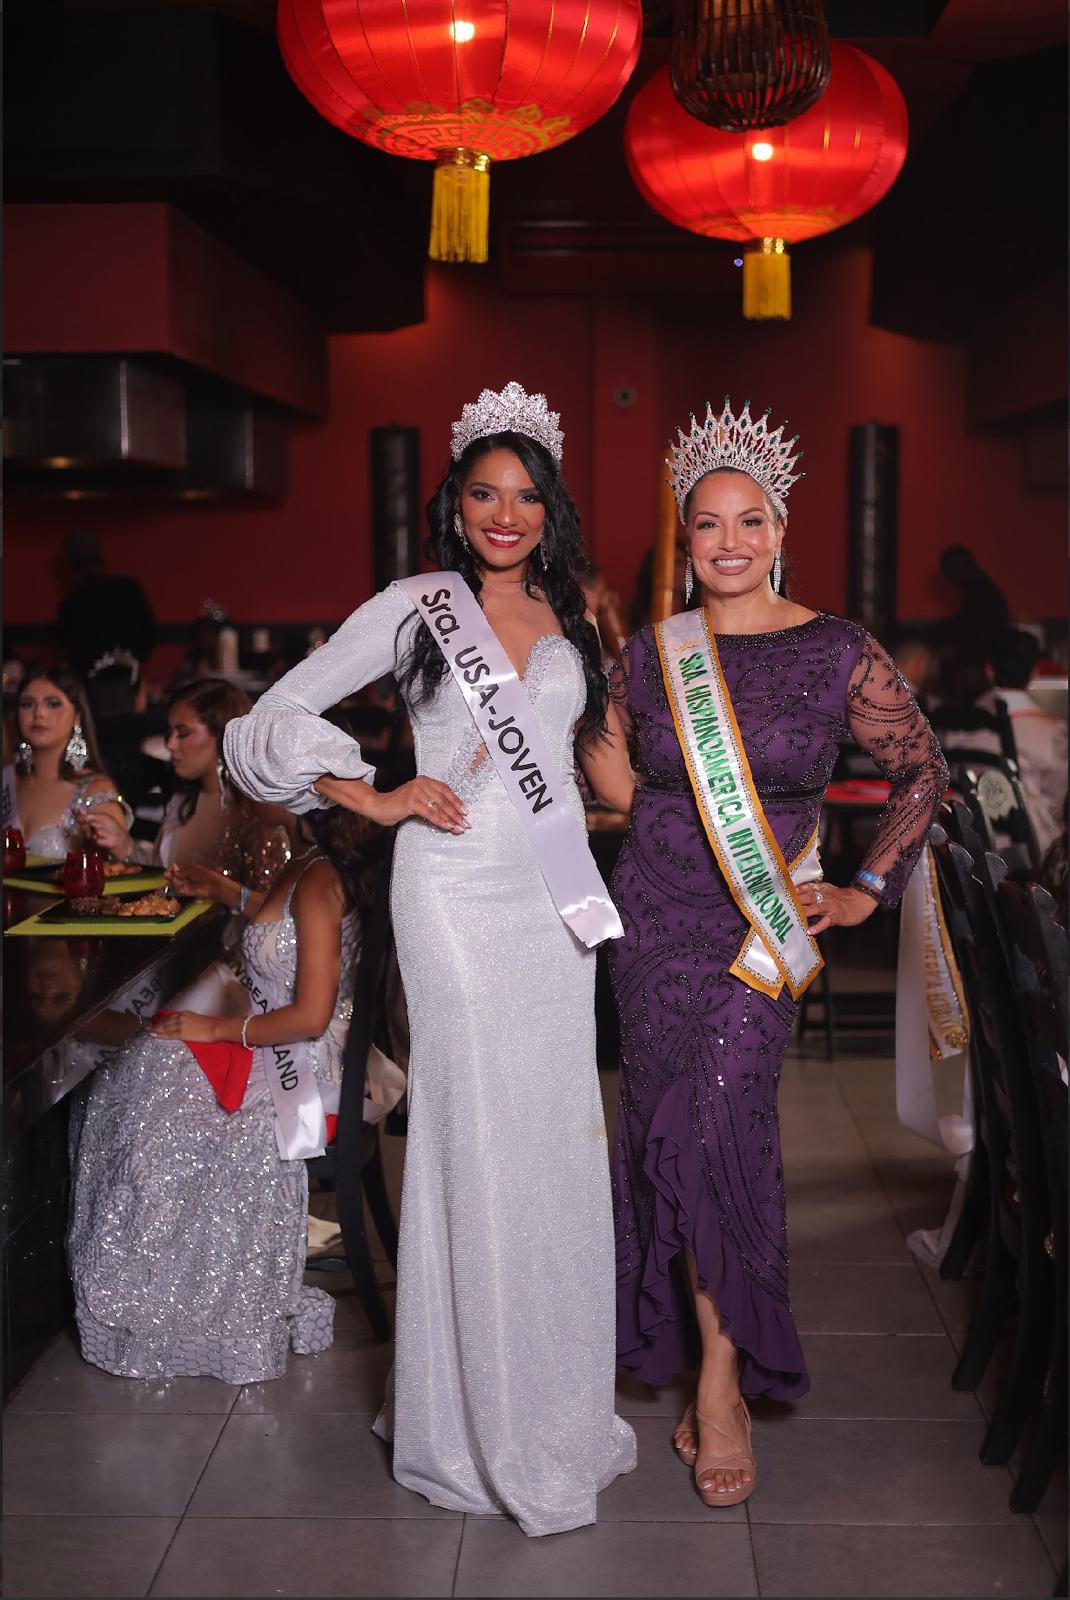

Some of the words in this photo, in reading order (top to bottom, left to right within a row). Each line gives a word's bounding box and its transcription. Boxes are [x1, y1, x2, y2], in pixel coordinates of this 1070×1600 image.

[421, 588, 460, 644] Sra.
[454, 645, 553, 815] USA-JOVEN
[684, 686, 748, 828] HISPANOAMERICA
